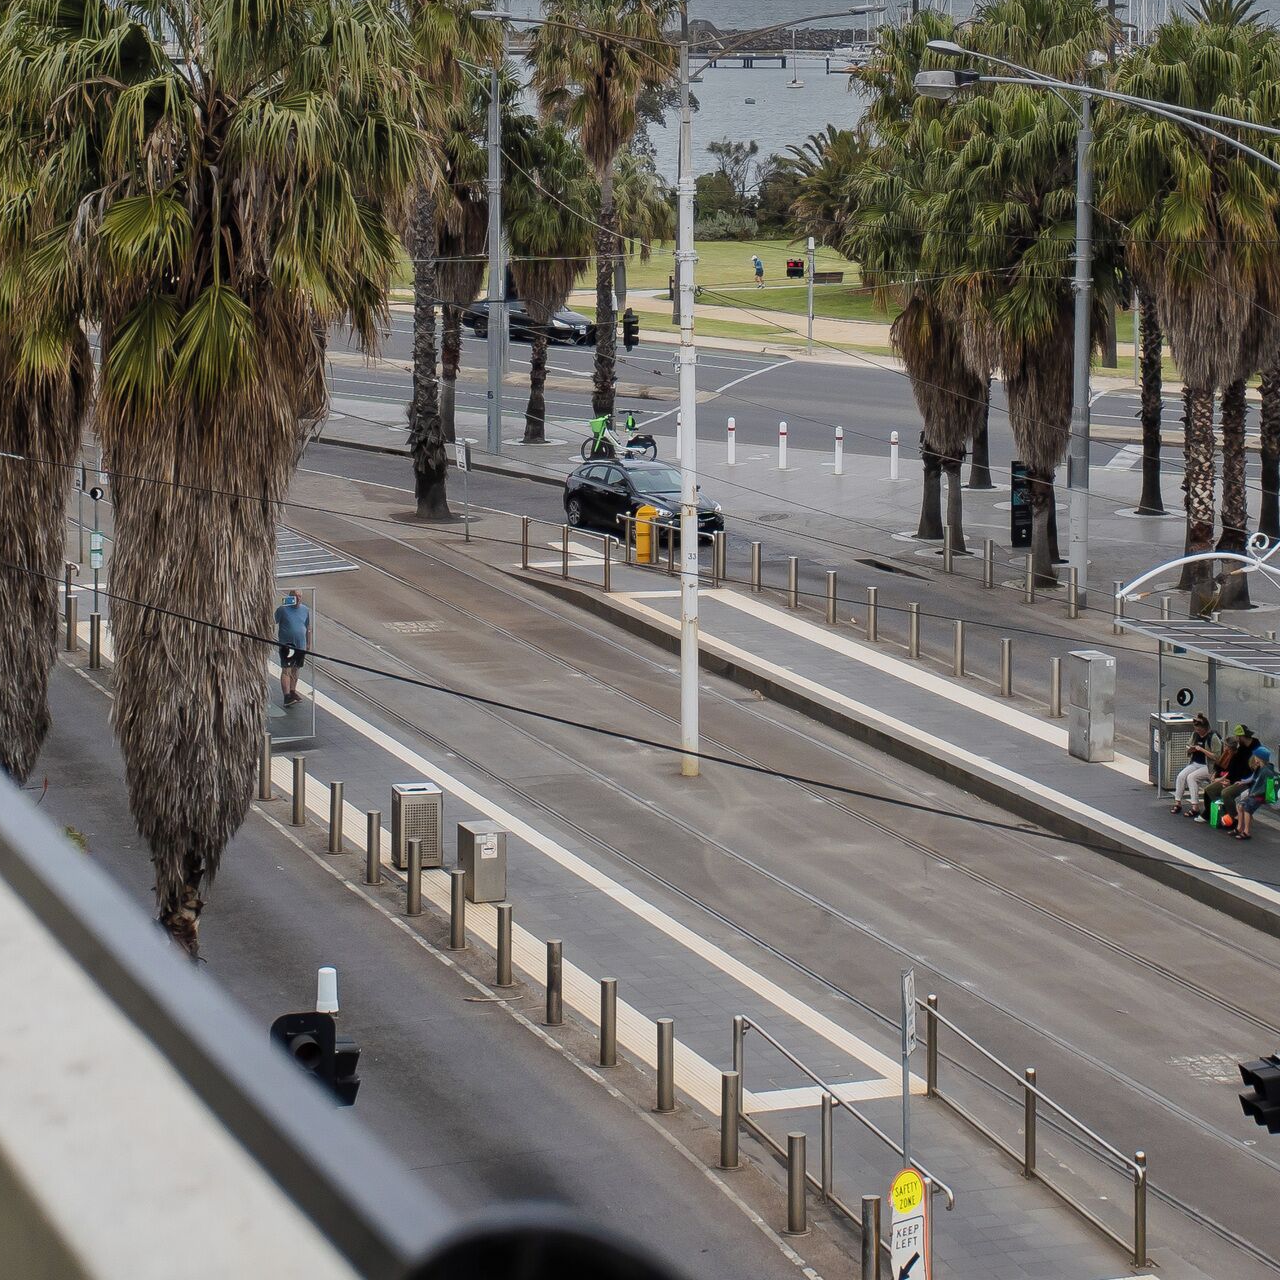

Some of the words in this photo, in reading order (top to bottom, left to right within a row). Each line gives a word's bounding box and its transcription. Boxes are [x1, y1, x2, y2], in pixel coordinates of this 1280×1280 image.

[894, 1180, 919, 1198] SAFETY
[899, 1195, 916, 1210] ZONE
[896, 1223, 920, 1239] KEEP
[895, 1236, 918, 1250] LEFT
